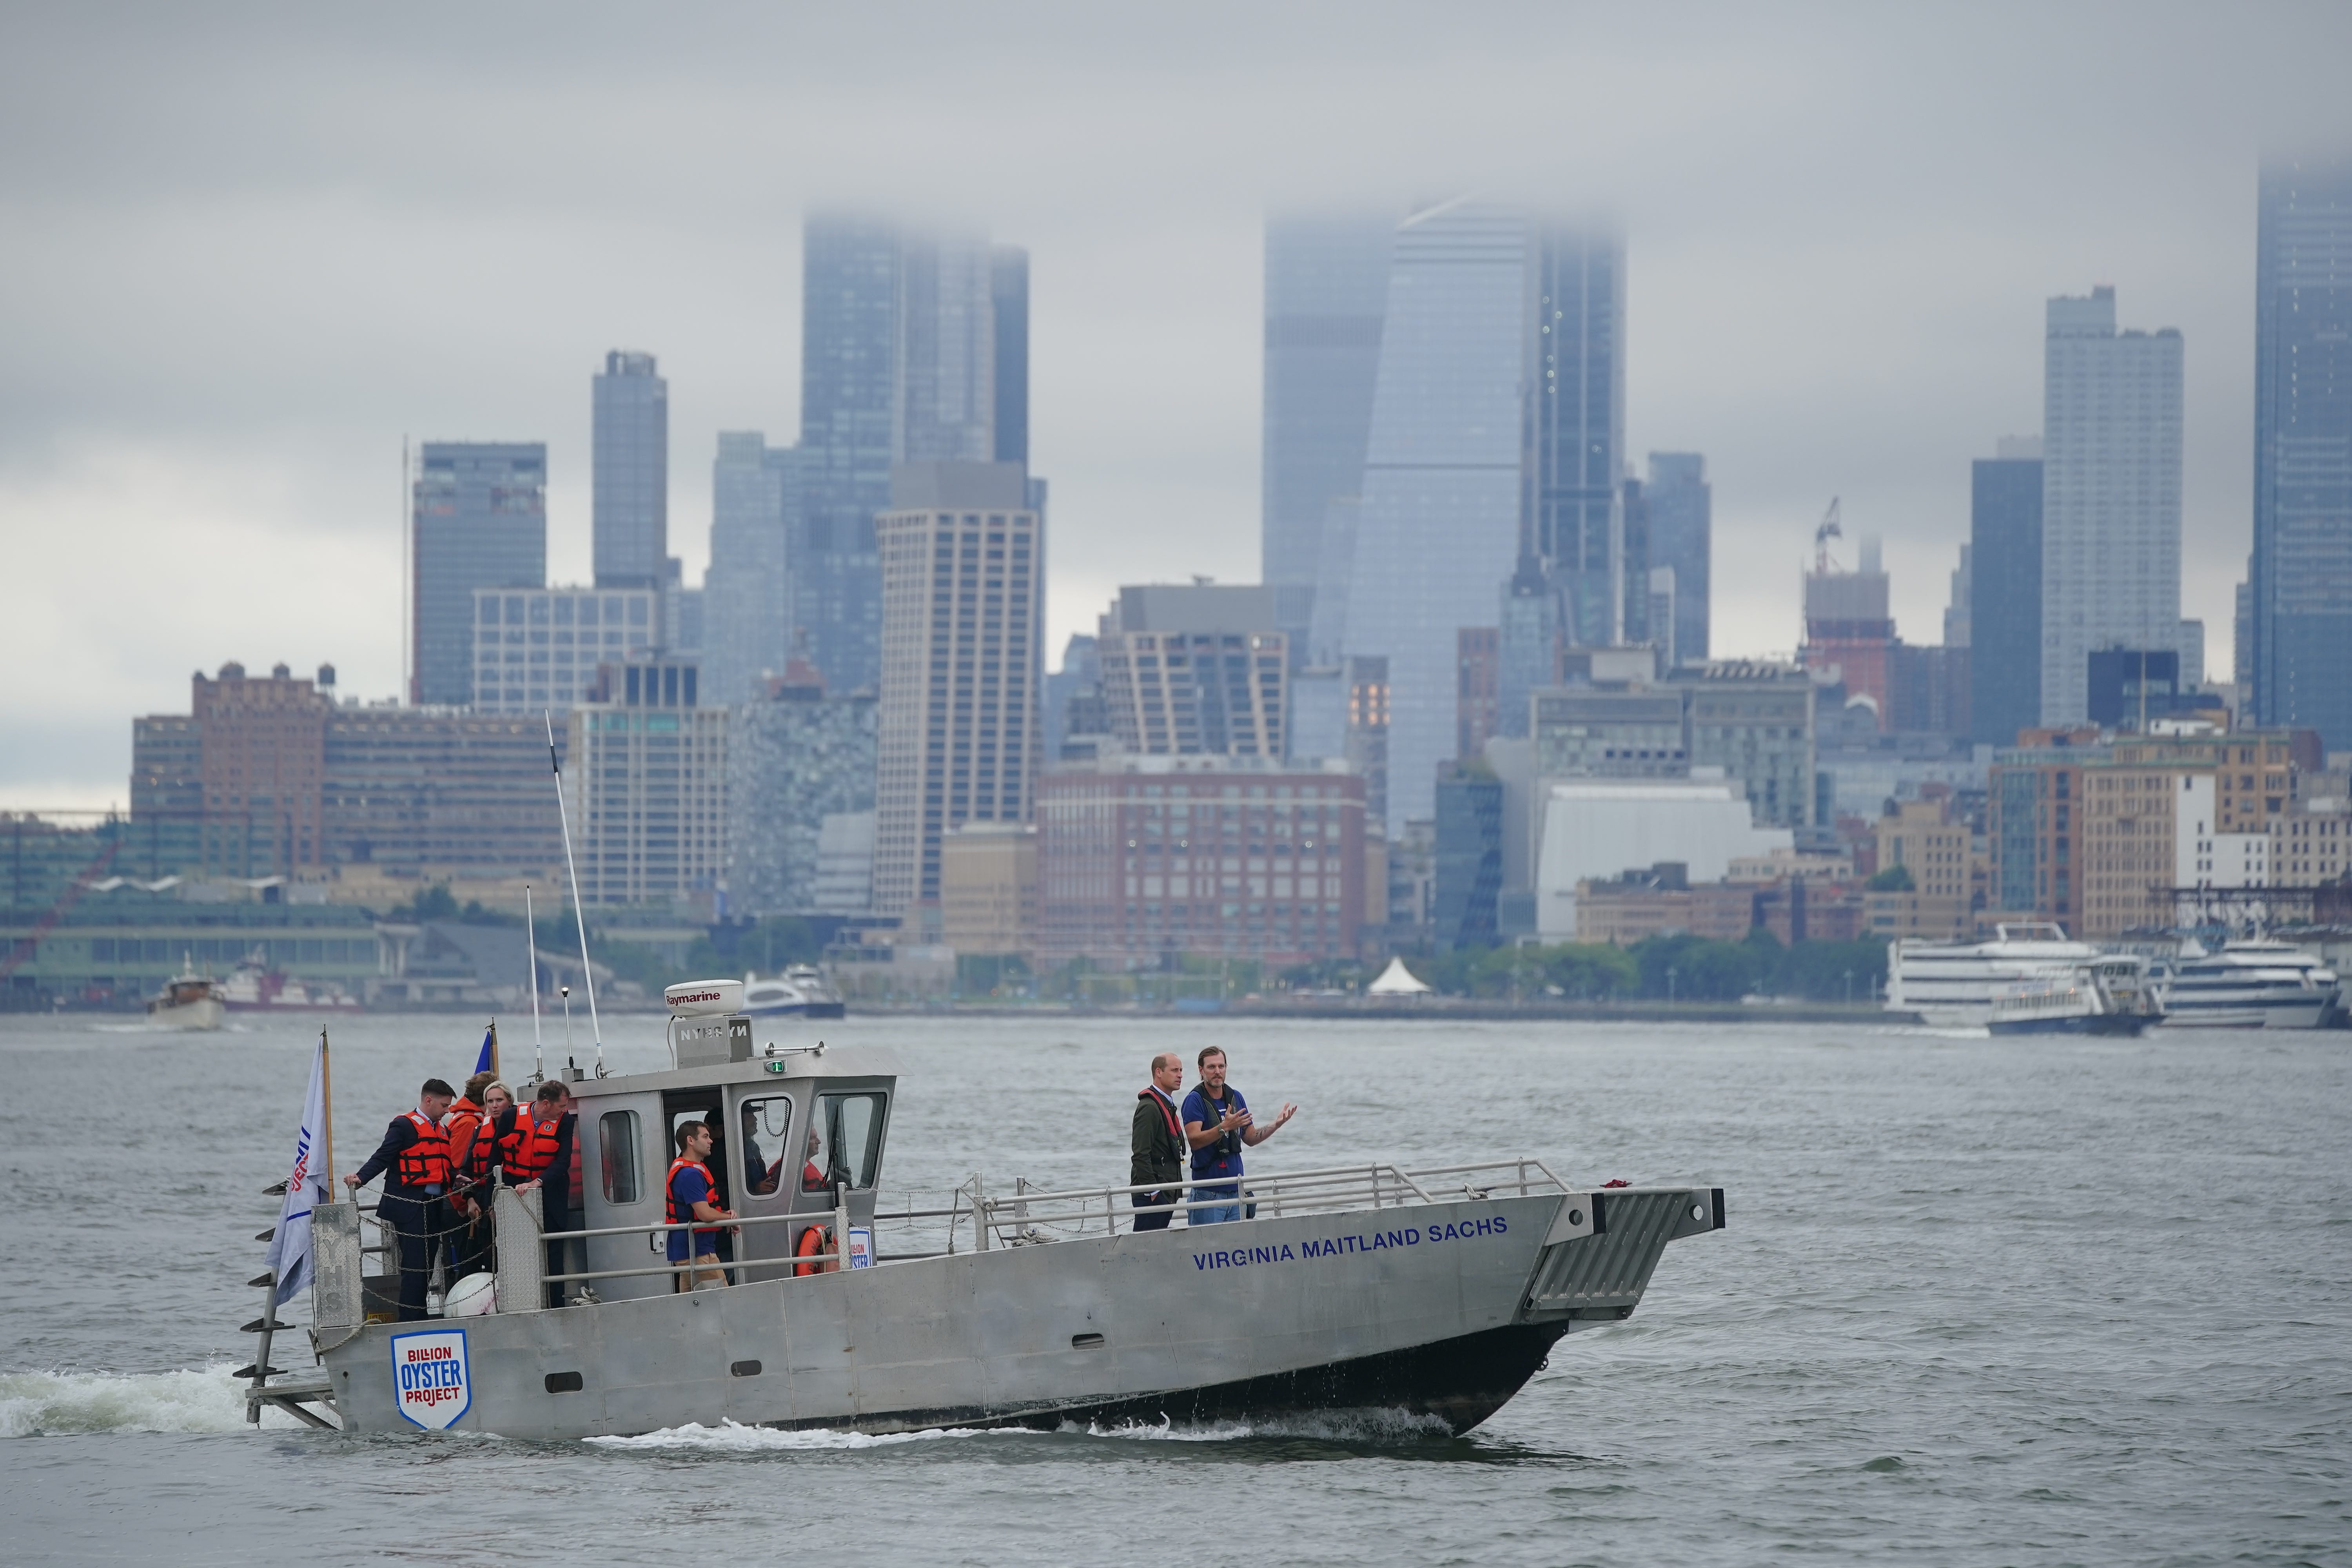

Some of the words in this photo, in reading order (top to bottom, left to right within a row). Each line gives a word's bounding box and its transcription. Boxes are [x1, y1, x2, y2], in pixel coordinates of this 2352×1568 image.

[666, 991, 721, 1006] Raymarine
[681, 1026, 723, 1041] NYHS
[850, 1244, 865, 1254] ILLION
[1192, 1244, 1295, 1271] VIRGINIA
[1301, 1228, 1420, 1259] MAITLAND
[1428, 1216, 1508, 1242] SACHS
[407, 1347, 452, 1362] BILLION
[401, 1359, 463, 1390] OYSTER
[405, 1387, 460, 1407] PROJECT
